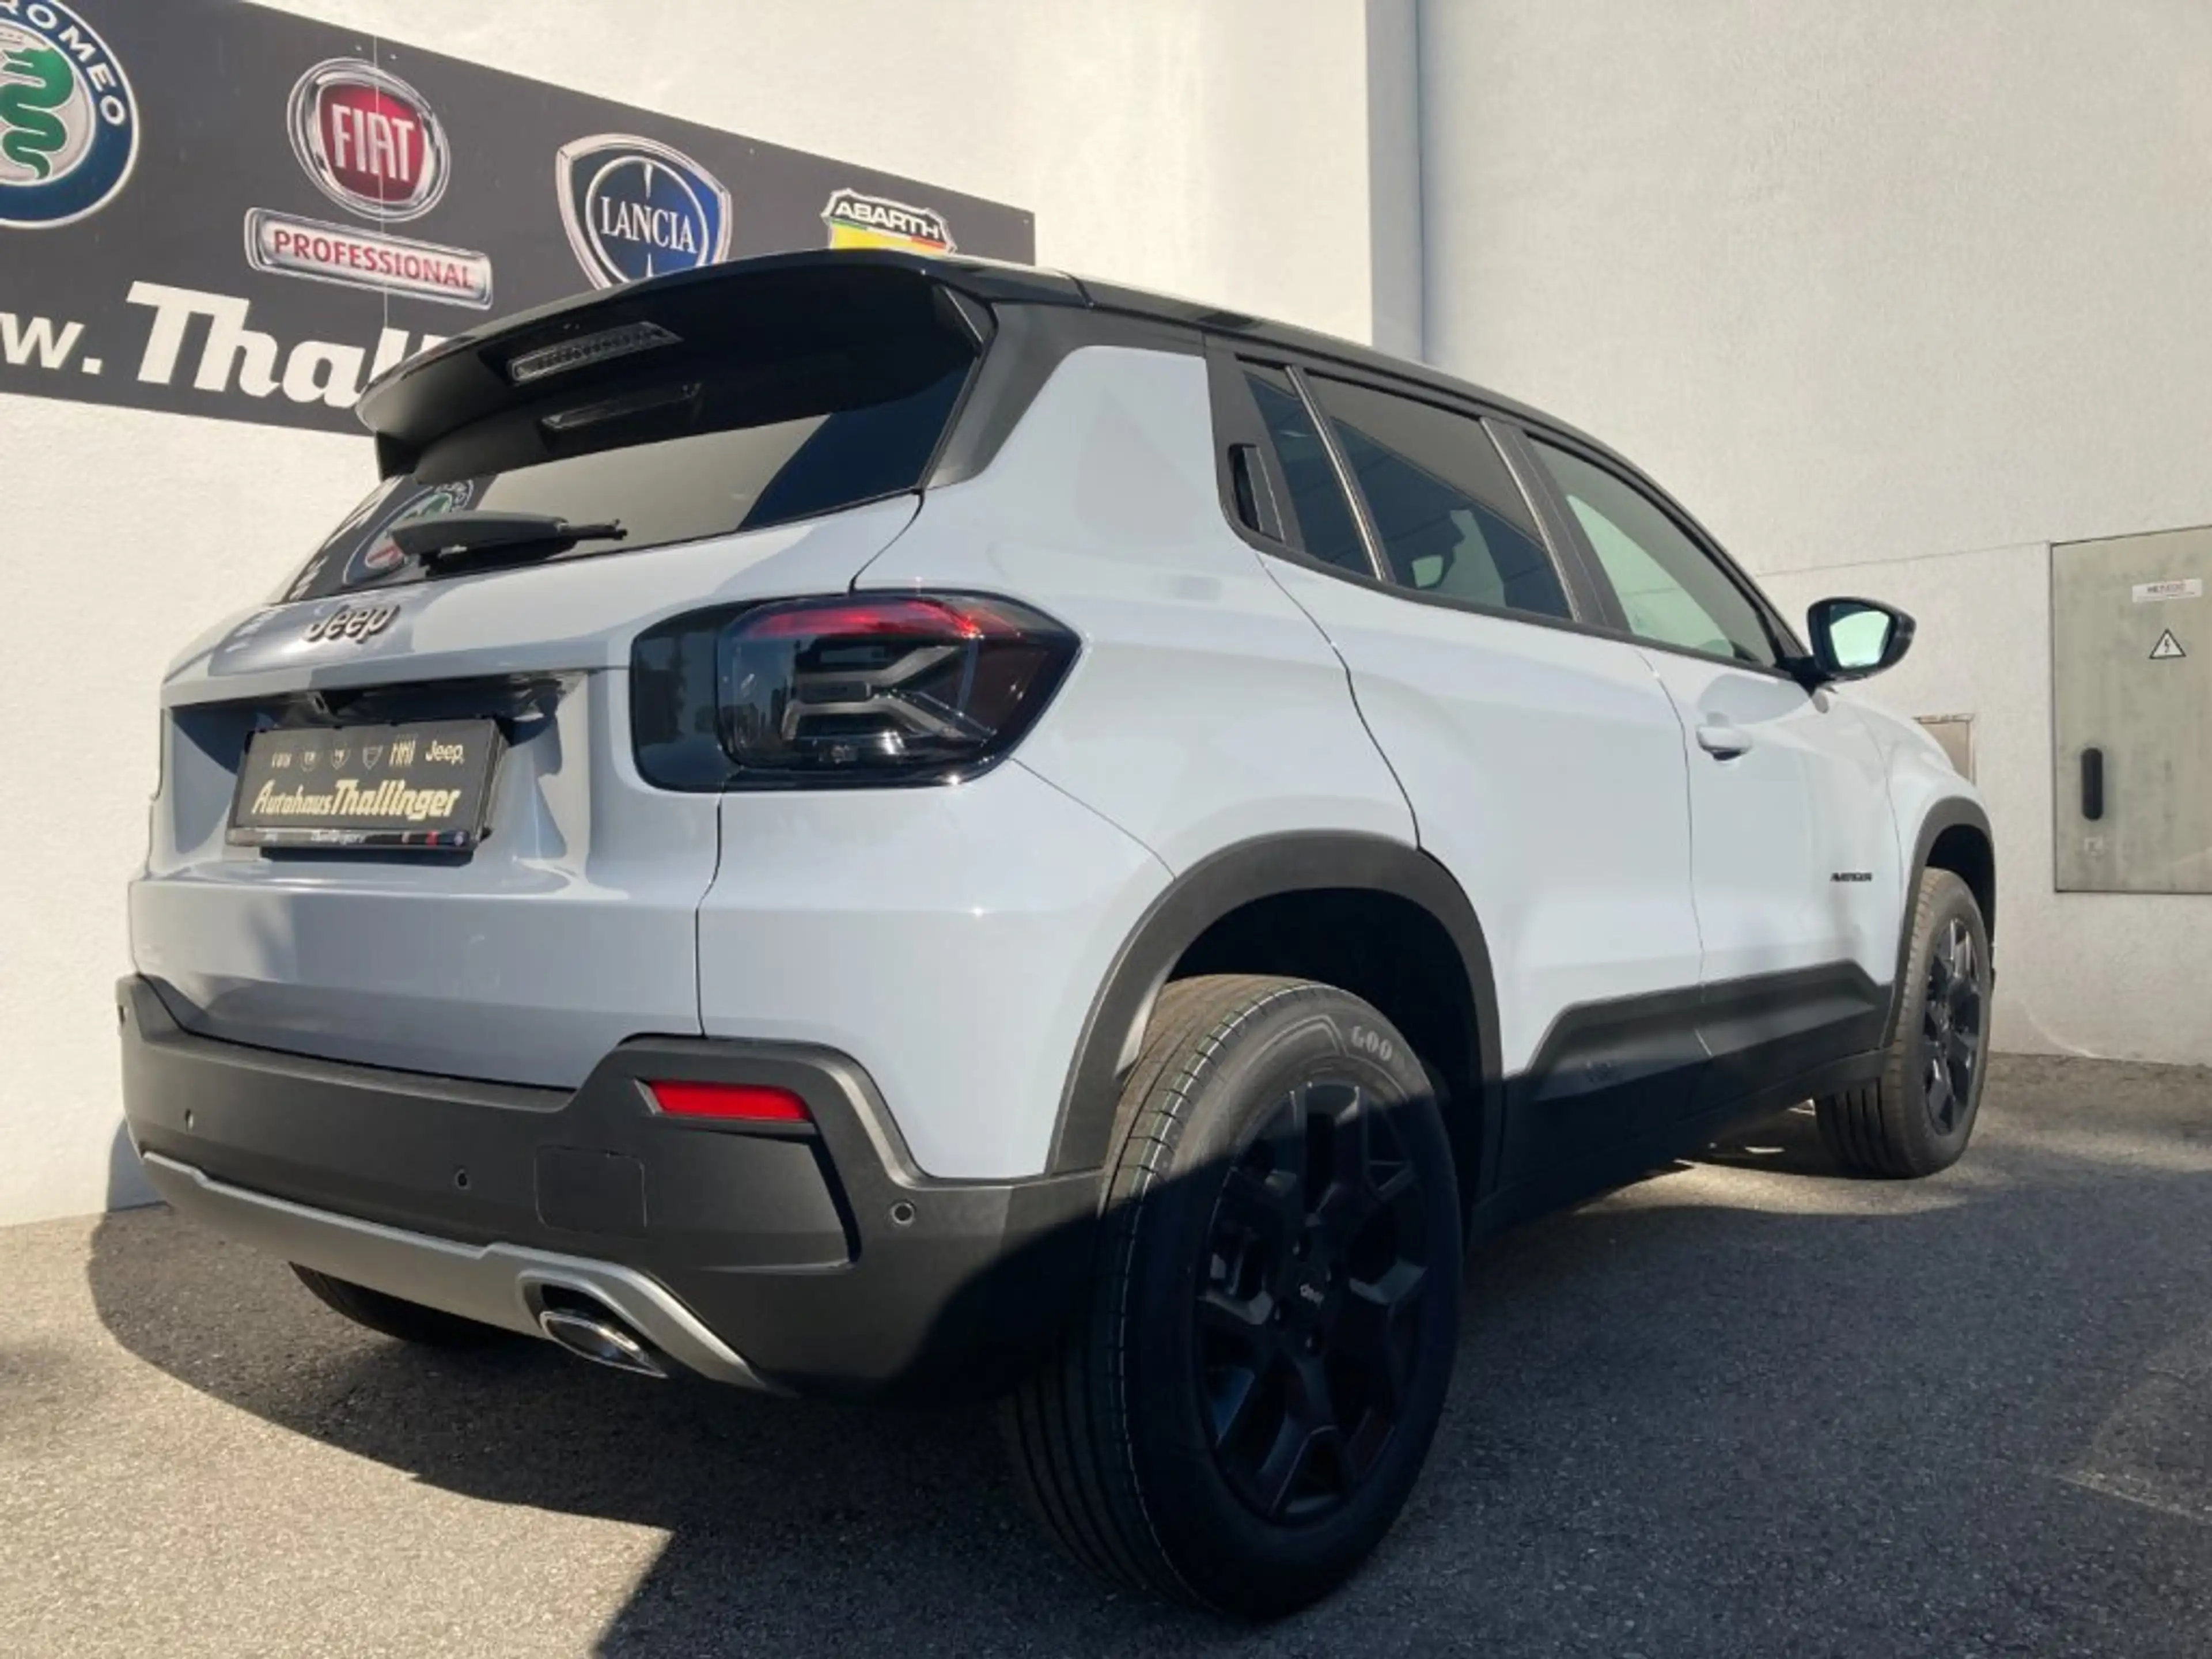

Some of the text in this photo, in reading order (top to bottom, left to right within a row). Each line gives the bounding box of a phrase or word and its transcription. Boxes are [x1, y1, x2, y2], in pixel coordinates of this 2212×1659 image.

[332, 103, 415, 182] FIAT
[600, 195, 698, 254] LANCIA
[835, 200, 942, 240] ABARTH
[274, 230, 475, 290] PROFESSIONAL
[305, 604, 400, 645] Jeep
